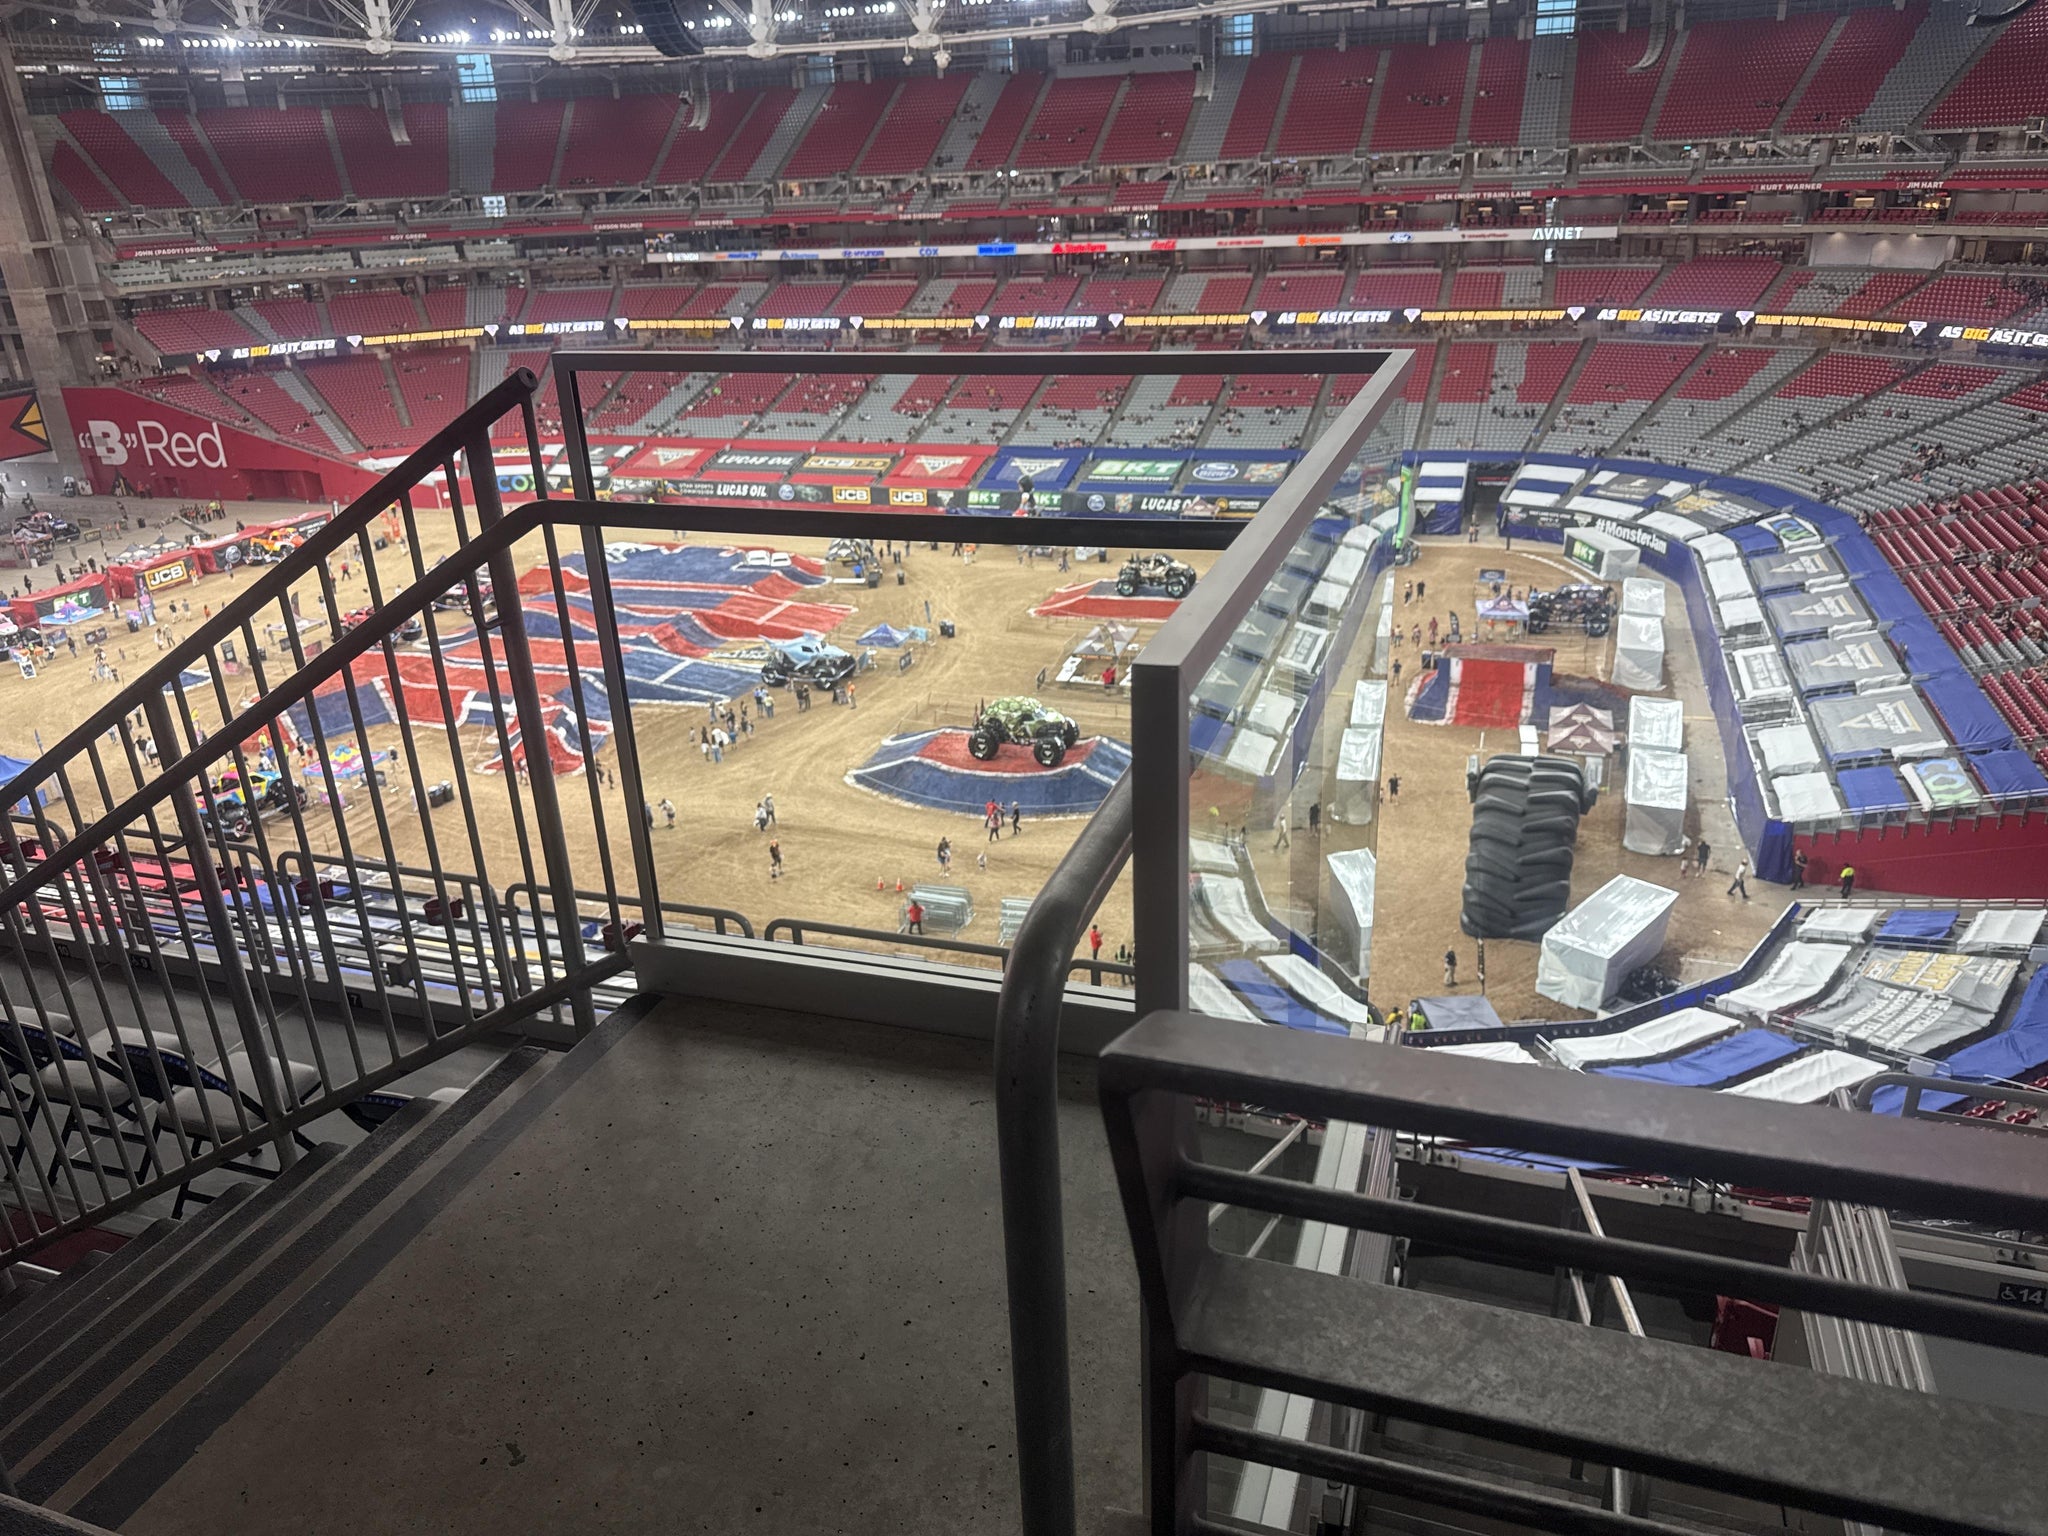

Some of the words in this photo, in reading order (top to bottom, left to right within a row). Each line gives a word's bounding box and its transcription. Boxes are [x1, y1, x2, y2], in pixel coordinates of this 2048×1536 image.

[1760, 183, 1783, 191] KURT
[1785, 183, 1822, 191] WARNER
[1921, 181, 1944, 189] HART
[1532, 227, 1584, 240] AVNET
[155, 248, 184, 256] (PADDY)
[185, 245, 218, 253] DRISCOLL
[919, 247, 939, 257] COX
[999, 316, 1016, 329] AS
[1015, 316, 1035, 329] BIG
[1035, 316, 1052, 329] AS
[1050, 316, 1065, 329] IT
[1277, 311, 1297, 324] AS
[1296, 311, 1320, 324] BIG
[1318, 311, 1339, 324] AS
[1337, 311, 1354, 324] IT
[1597, 308, 1618, 320] AS
[1617, 309, 1642, 321] BIG
[1641, 310, 1662, 322] AS
[1660, 310, 1681, 323] IT
[1679, 311, 1722, 324] GETS!
[508, 324, 525, 335] AS
[525, 323, 544, 334] BIG
[544, 322, 560, 334] AS
[559, 322, 573, 334] IT
[752, 318, 767, 329] AS
[767, 318, 785, 329] BIG
[784, 317, 799, 329] AS
[798, 318, 811, 330] IT
[1754, 314, 1783, 325] THANK
[1782, 315, 1799, 326] YOU
[1799, 315, 1816, 326] FOR
[1853, 319, 1869, 331] THE
[1868, 321, 1882, 331] PIT
[1880, 322, 1907, 333] PARTY
[1939, 325, 1963, 339] AS
[1962, 327, 1991, 341] BIG
[1989, 329, 2014, 344] AS
[2012, 331, 2034, 346] IT
[232, 347, 249, 359] AS
[250, 345, 270, 357] BIG
[270, 343, 287, 356] AS
[286, 341, 301, 354] IT
[137, 420, 228, 468] Red
[1097, 461, 1178, 475] BKT
[716, 483, 748, 496] LUCAS
[749, 484, 768, 497] OIL
[835, 489, 868, 501] JCB
[892, 491, 925, 502] JCB
[968, 491, 1000, 505] BKT
[1141, 497, 1181, 511] LUCAS
[1595, 518, 1668, 555] #MonsterJam
[1573, 539, 1596, 562] BKT
[150, 565, 183, 585] JCB
[2019, 1287, 2043, 1305] 14
